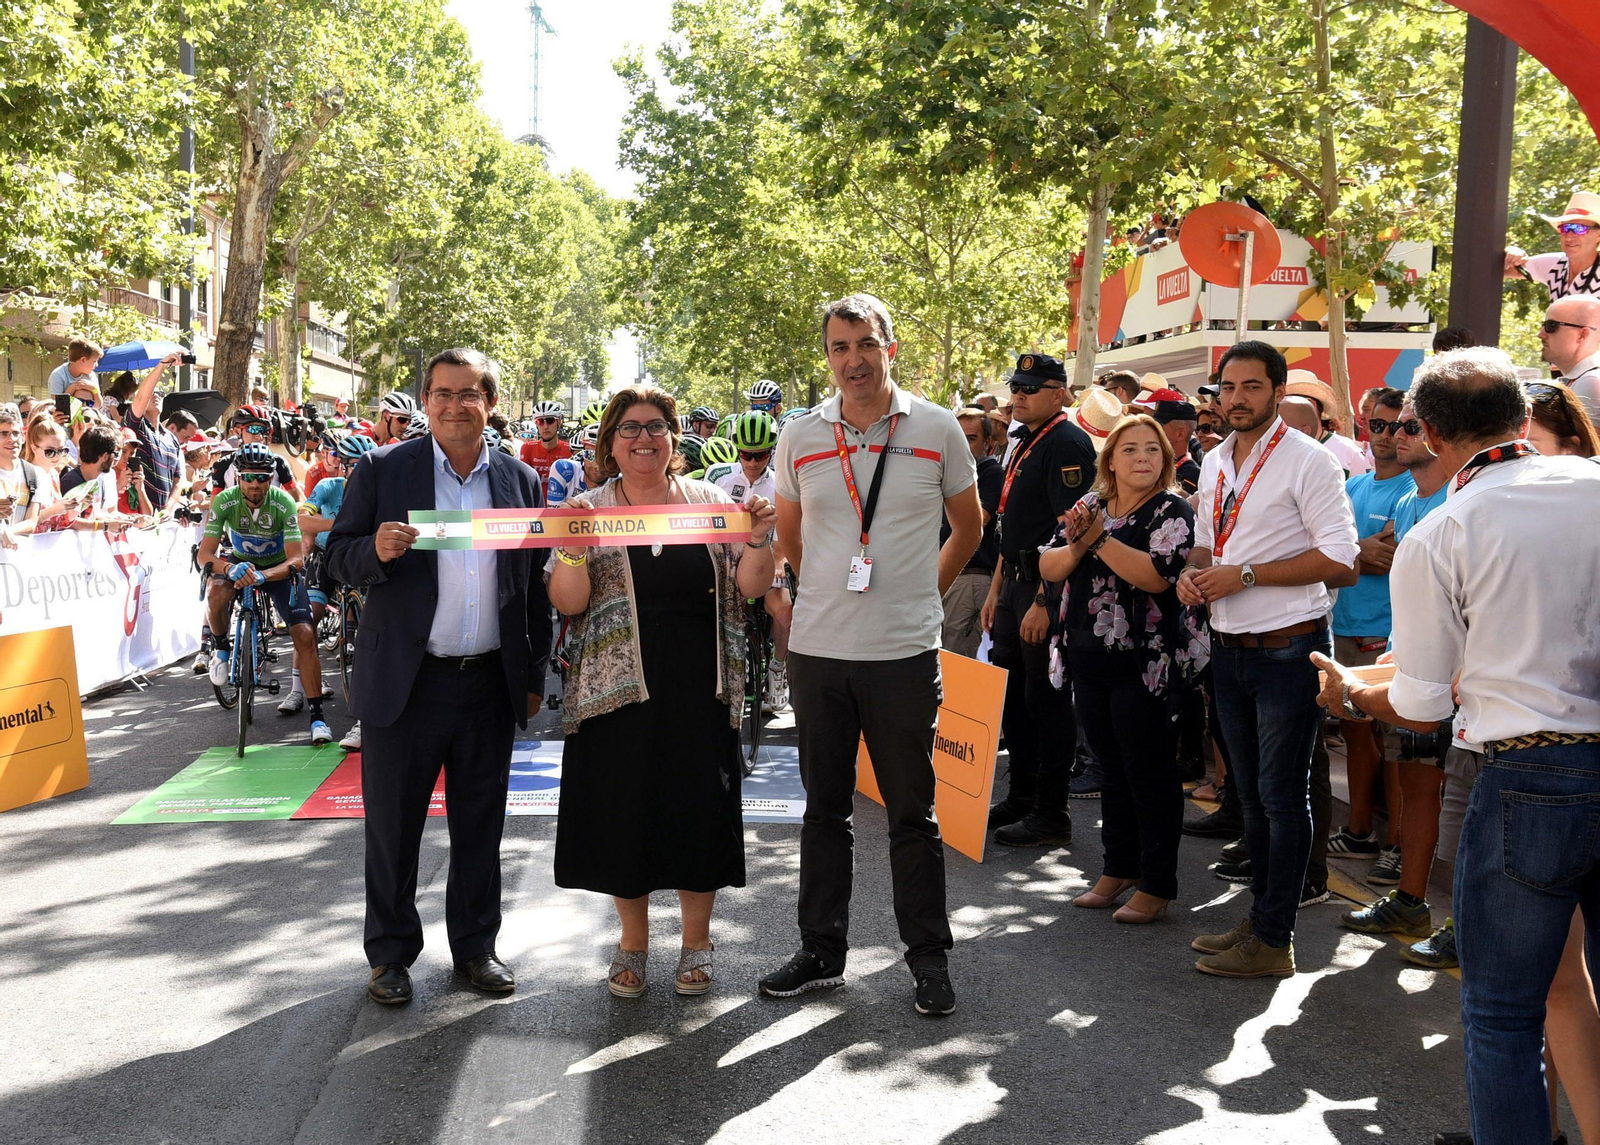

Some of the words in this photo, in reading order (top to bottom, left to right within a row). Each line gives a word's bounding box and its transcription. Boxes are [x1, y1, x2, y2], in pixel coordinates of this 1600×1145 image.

[1159, 279, 1166, 300] LA
[1166, 271, 1188, 298] VUELTA
[489, 523, 498, 533] LA
[499, 522, 527, 533] VUELTA
[532, 523, 542, 532] 18
[568, 519, 646, 534] GRANADA
[672, 518, 681, 529] LA
[682, 518, 710, 528] VUELTA
[715, 517, 723, 527] 18
[0, 562, 117, 620] Deportes
[0, 704, 44, 730] nental
[935, 729, 968, 762] inental
